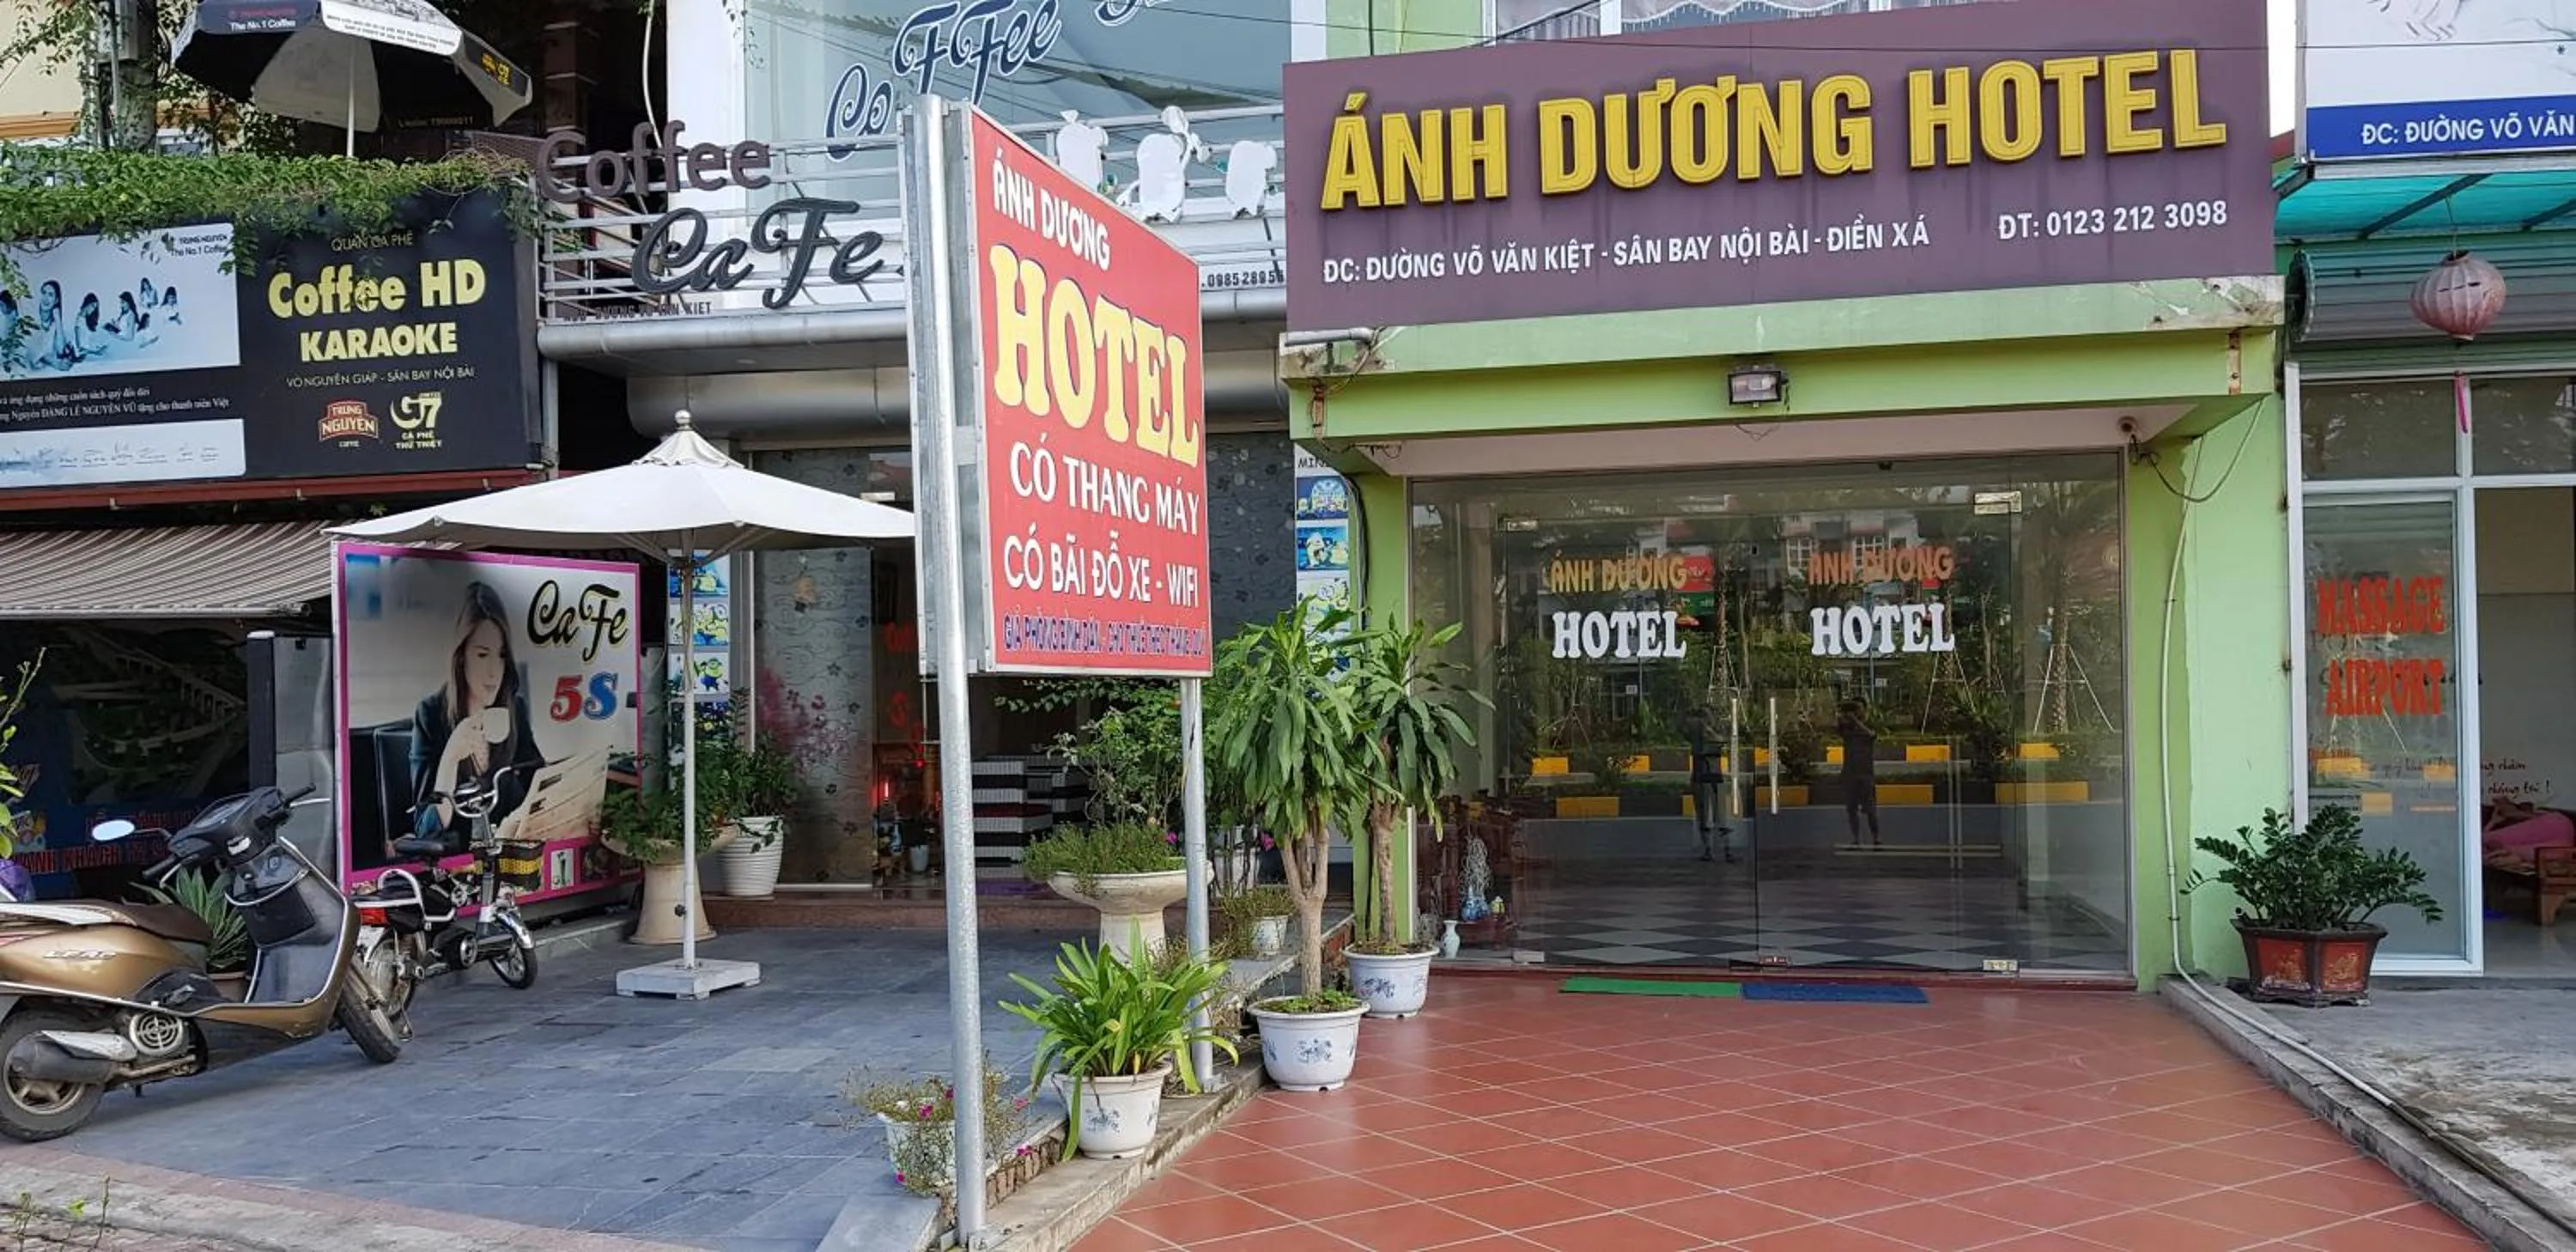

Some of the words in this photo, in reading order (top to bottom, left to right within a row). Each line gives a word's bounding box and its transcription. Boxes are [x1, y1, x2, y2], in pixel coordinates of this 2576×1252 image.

[1320, 92, 1510, 211] ÁNH
[1539, 75, 1874, 195] DƯƠNG
[1908, 48, 2227, 169] HOTEL
[2361, 123, 2398, 144] ĐC:
[2405, 113, 2484, 143] ĐƯỜNG
[2490, 111, 2522, 138] VÕ
[2528, 109, 2575, 137] VĂN
[536, 119, 771, 203] Coffee
[992, 147, 1036, 233] ÁNH
[1041, 188, 1110, 271] DƯƠNG
[1998, 214, 2038, 240] ĐT:
[2046, 207, 2105, 238] 0123
[2113, 204, 2154, 233] 212
[2164, 199, 2227, 229] 3098
[632, 197, 884, 309] CaFe
[1323, 258, 1360, 283] ĐC:
[1365, 246, 1445, 282] ĐƯỜNG
[1454, 243, 1484, 276] VÕ
[1491, 241, 1537, 274] VĂN
[1545, 238, 1595, 276] KIỆT
[1613, 234, 1662, 266] SÂN
[1668, 234, 1713, 263] BAY
[1720, 226, 1761, 266] NỘI
[1769, 225, 1809, 257] BÀI
[1827, 212, 1883, 252] ĐIỀN
[269, 264, 407, 319] Coffee
[419, 258, 486, 307] HD
[301, 322, 458, 362] KARAOKE
[990, 243, 1200, 469] HOTEL
[411, 368, 430, 380] BAY
[332, 404, 362, 416] TRUNG
[1010, 432, 1057, 502] CÓ
[1062, 454, 1151, 523] THANG
[1155, 477, 1200, 535] MÁY
[1003, 522, 1044, 591] CÓ
[1050, 532, 1086, 594] BÃI
[1091, 529, 1124, 599] ĐỖ
[1127, 556, 1151, 602] XE
[1166, 562, 1199, 608] WIFI
[1551, 549, 1595, 593] ÁNH
[526, 579, 629, 663] CaFe
[1551, 608, 1687, 660] HOTEL
[1809, 602, 1956, 656] HOTEL
[2317, 575, 2446, 634] MASSAGE
[550, 671, 618, 722] 5S
[2324, 658, 2445, 715] AIRPORT
